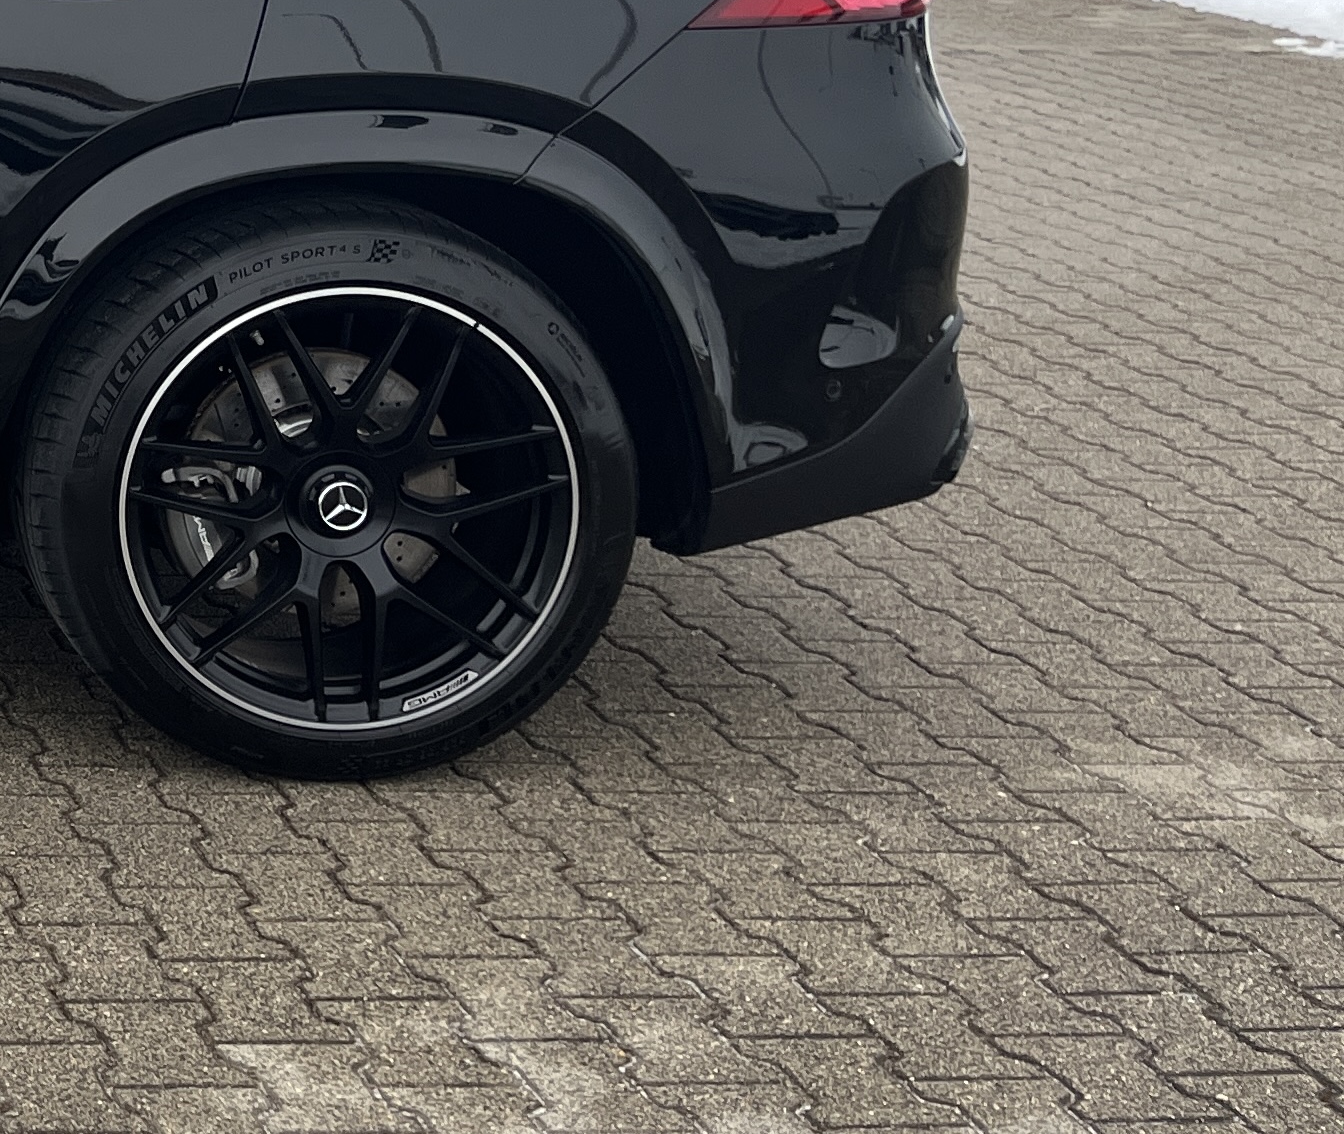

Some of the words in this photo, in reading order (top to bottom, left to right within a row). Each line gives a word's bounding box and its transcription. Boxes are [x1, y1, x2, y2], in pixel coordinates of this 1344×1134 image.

[228, 257, 274, 284] PILOT
[280, 244, 339, 265] SPORT
[89, 283, 212, 428] MICHELIN
